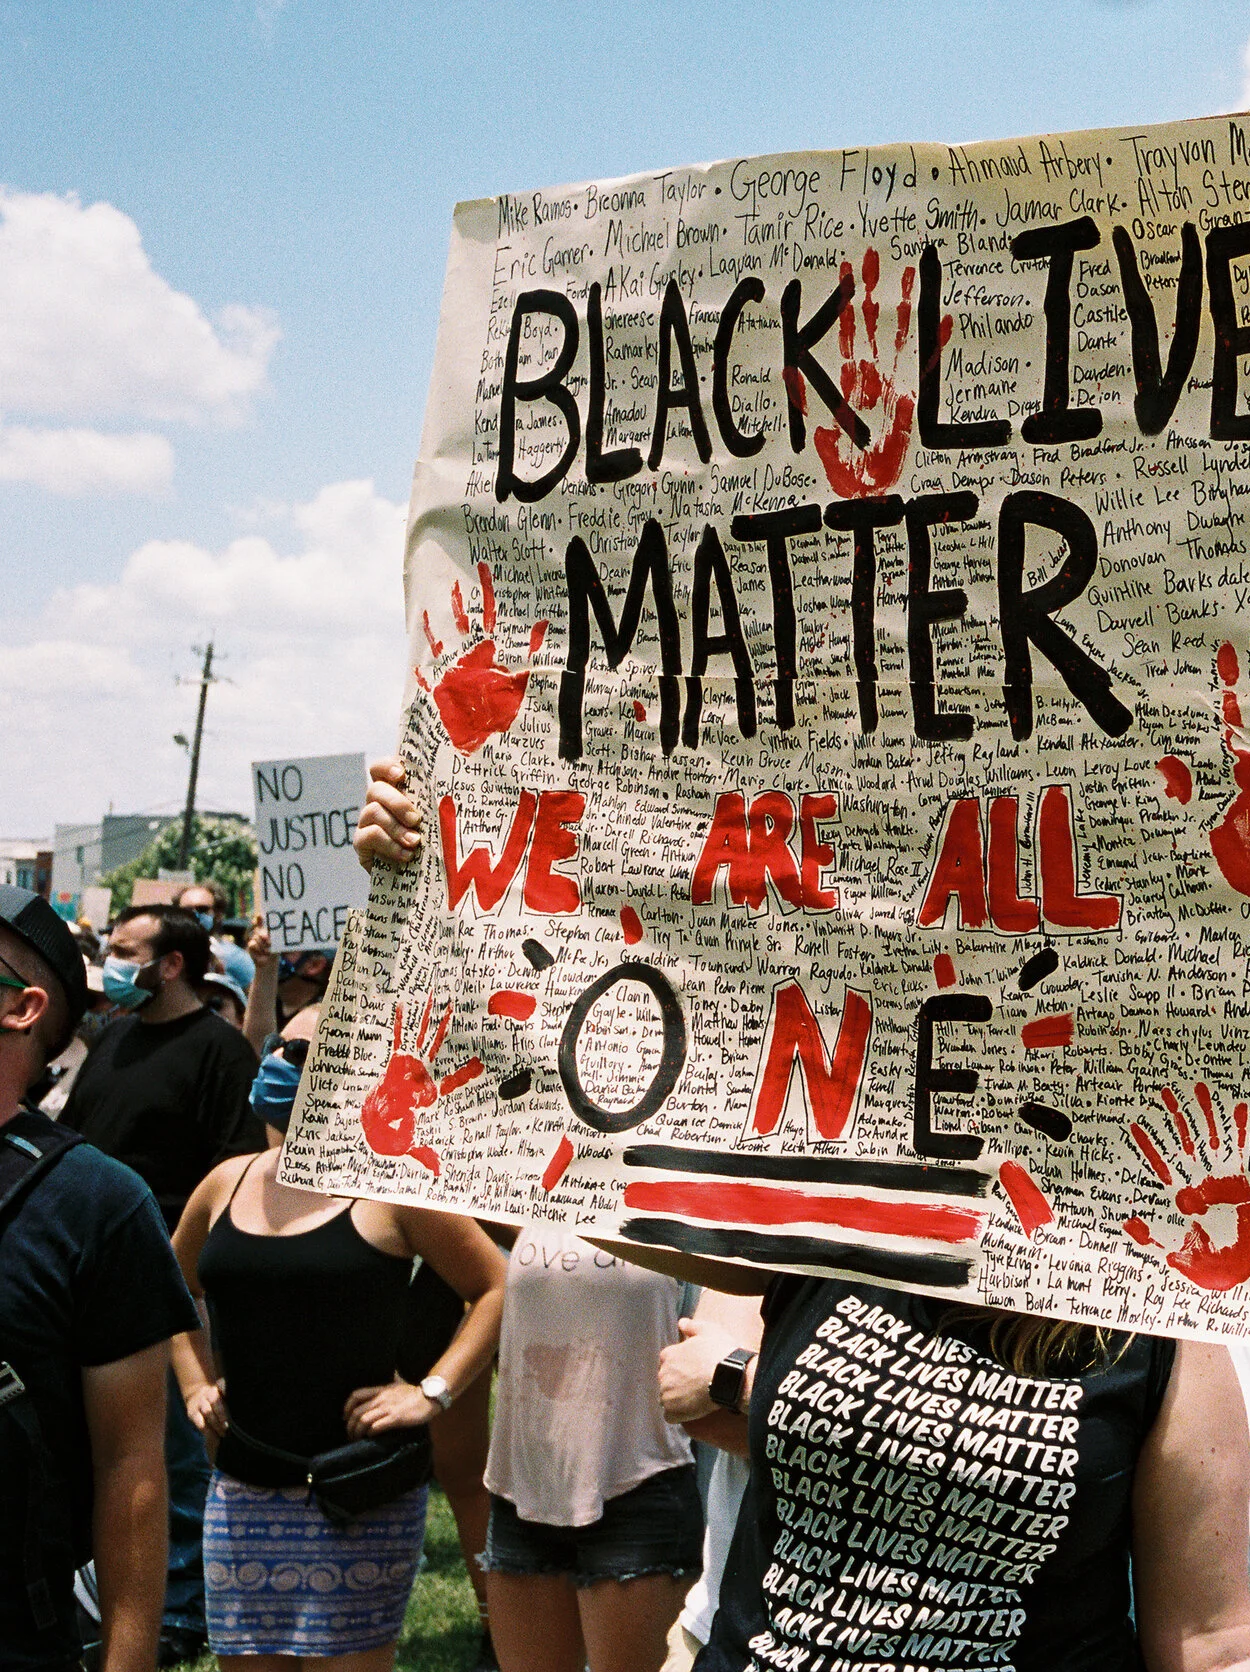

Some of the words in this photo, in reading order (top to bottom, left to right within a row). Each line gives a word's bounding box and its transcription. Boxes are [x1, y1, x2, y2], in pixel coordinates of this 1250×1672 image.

[498, 195, 529, 238] Mike
[585, 184, 646, 220] Breonna
[730, 160, 821, 219] George
[840, 146, 917, 198] Floyd
[947, 147, 1028, 187] Ahmaud
[1119, 133, 1216, 177] Trayvon
[493, 246, 536, 287] Eric
[604, 221, 670, 259] Michael
[676, 219, 719, 246] Brown
[734, 212, 794, 247] Tamir
[803, 202, 844, 241] Rice
[857, 200, 917, 237] Yvette
[924, 198, 979, 232] Smith
[996, 201, 1063, 228] Jamar
[1069, 190, 1119, 220] Clark
[1138, 176, 1194, 215] Alton
[957, 231, 1009, 256] Bland
[1132, 220, 1177, 241] Oscar
[523, 317, 553, 341] Boyd
[959, 312, 1033, 339] Philando
[1073, 301, 1128, 328] Castile
[495, 272, 871, 503] BLACK
[732, 366, 771, 387] Ronald
[945, 348, 1019, 381] Madison
[604, 400, 647, 427] Amadou
[732, 394, 770, 413] Diallo
[945, 379, 1017, 406] Jermaine
[710, 465, 758, 495] Samuel
[1095, 486, 1144, 516] Willie
[1154, 485, 1180, 504] Lee
[1133, 455, 1189, 480] Russell
[568, 502, 621, 530] Freddie
[669, 492, 723, 518] Natasha
[1102, 519, 1172, 548] Anthony
[512, 539, 546, 561] Scott
[588, 531, 639, 555] Christian
[664, 521, 701, 545] Taylor
[1100, 550, 1166, 579] Donovan
[1177, 537, 1247, 563] Thomas
[557, 489, 1134, 762] MATTER
[1097, 607, 1154, 633] Darrell
[1123, 633, 1160, 658] Sean
[256, 764, 303, 802] NO
[567, 773, 610, 792] George
[259, 806, 359, 855] JUSTICE
[262, 862, 305, 901] NO
[440, 788, 588, 916] WE
[690, 788, 841, 920] ARE
[917, 784, 1123, 935] ALL
[265, 904, 349, 947] PEACE
[1168, 945, 1220, 966] Michael
[1191, 985, 1236, 1000] Brian
[558, 960, 993, 1160] ONE
[575, 1210, 597, 1225] Lee
[835, 1295, 912, 1343] BLACK
[904, 1331, 979, 1365] LIVES
[816, 1315, 897, 1368] BLACK
[888, 1356, 968, 1393] LIVES
[968, 1371, 1084, 1411] MATTER
[795, 1343, 880, 1393] BLACK
[873, 1379, 962, 1419] LIVES
[958, 1402, 1081, 1444] MATTER
[777, 1370, 865, 1421] BLACK
[861, 1404, 953, 1447] LIVES
[952, 1427, 1080, 1477] MATTER
[767, 1399, 853, 1450] BLACK
[855, 1431, 947, 1476] LIVES
[948, 1457, 1077, 1510] MATTER
[764, 1433, 851, 1479] BLACK
[851, 1460, 942, 1506] LIVES
[940, 1487, 1069, 1539] MATTER
[770, 1466, 849, 1510] BLACK
[852, 1490, 936, 1533] LIVES
[935, 1514, 1058, 1562] MATTER
[772, 1528, 842, 1578] BLACK
[839, 1556, 919, 1598] LIVES
[775, 1497, 848, 1543] BLACK
[847, 1521, 929, 1566] LIVES
[926, 1542, 1042, 1585] MATTER
[762, 1562, 834, 1612] BLACK
[830, 1589, 912, 1631] LIVES
[909, 1606, 1028, 1639] MATTER
[815, 1622, 902, 1659] LIVES
[900, 1632, 1018, 1663] MATTER
